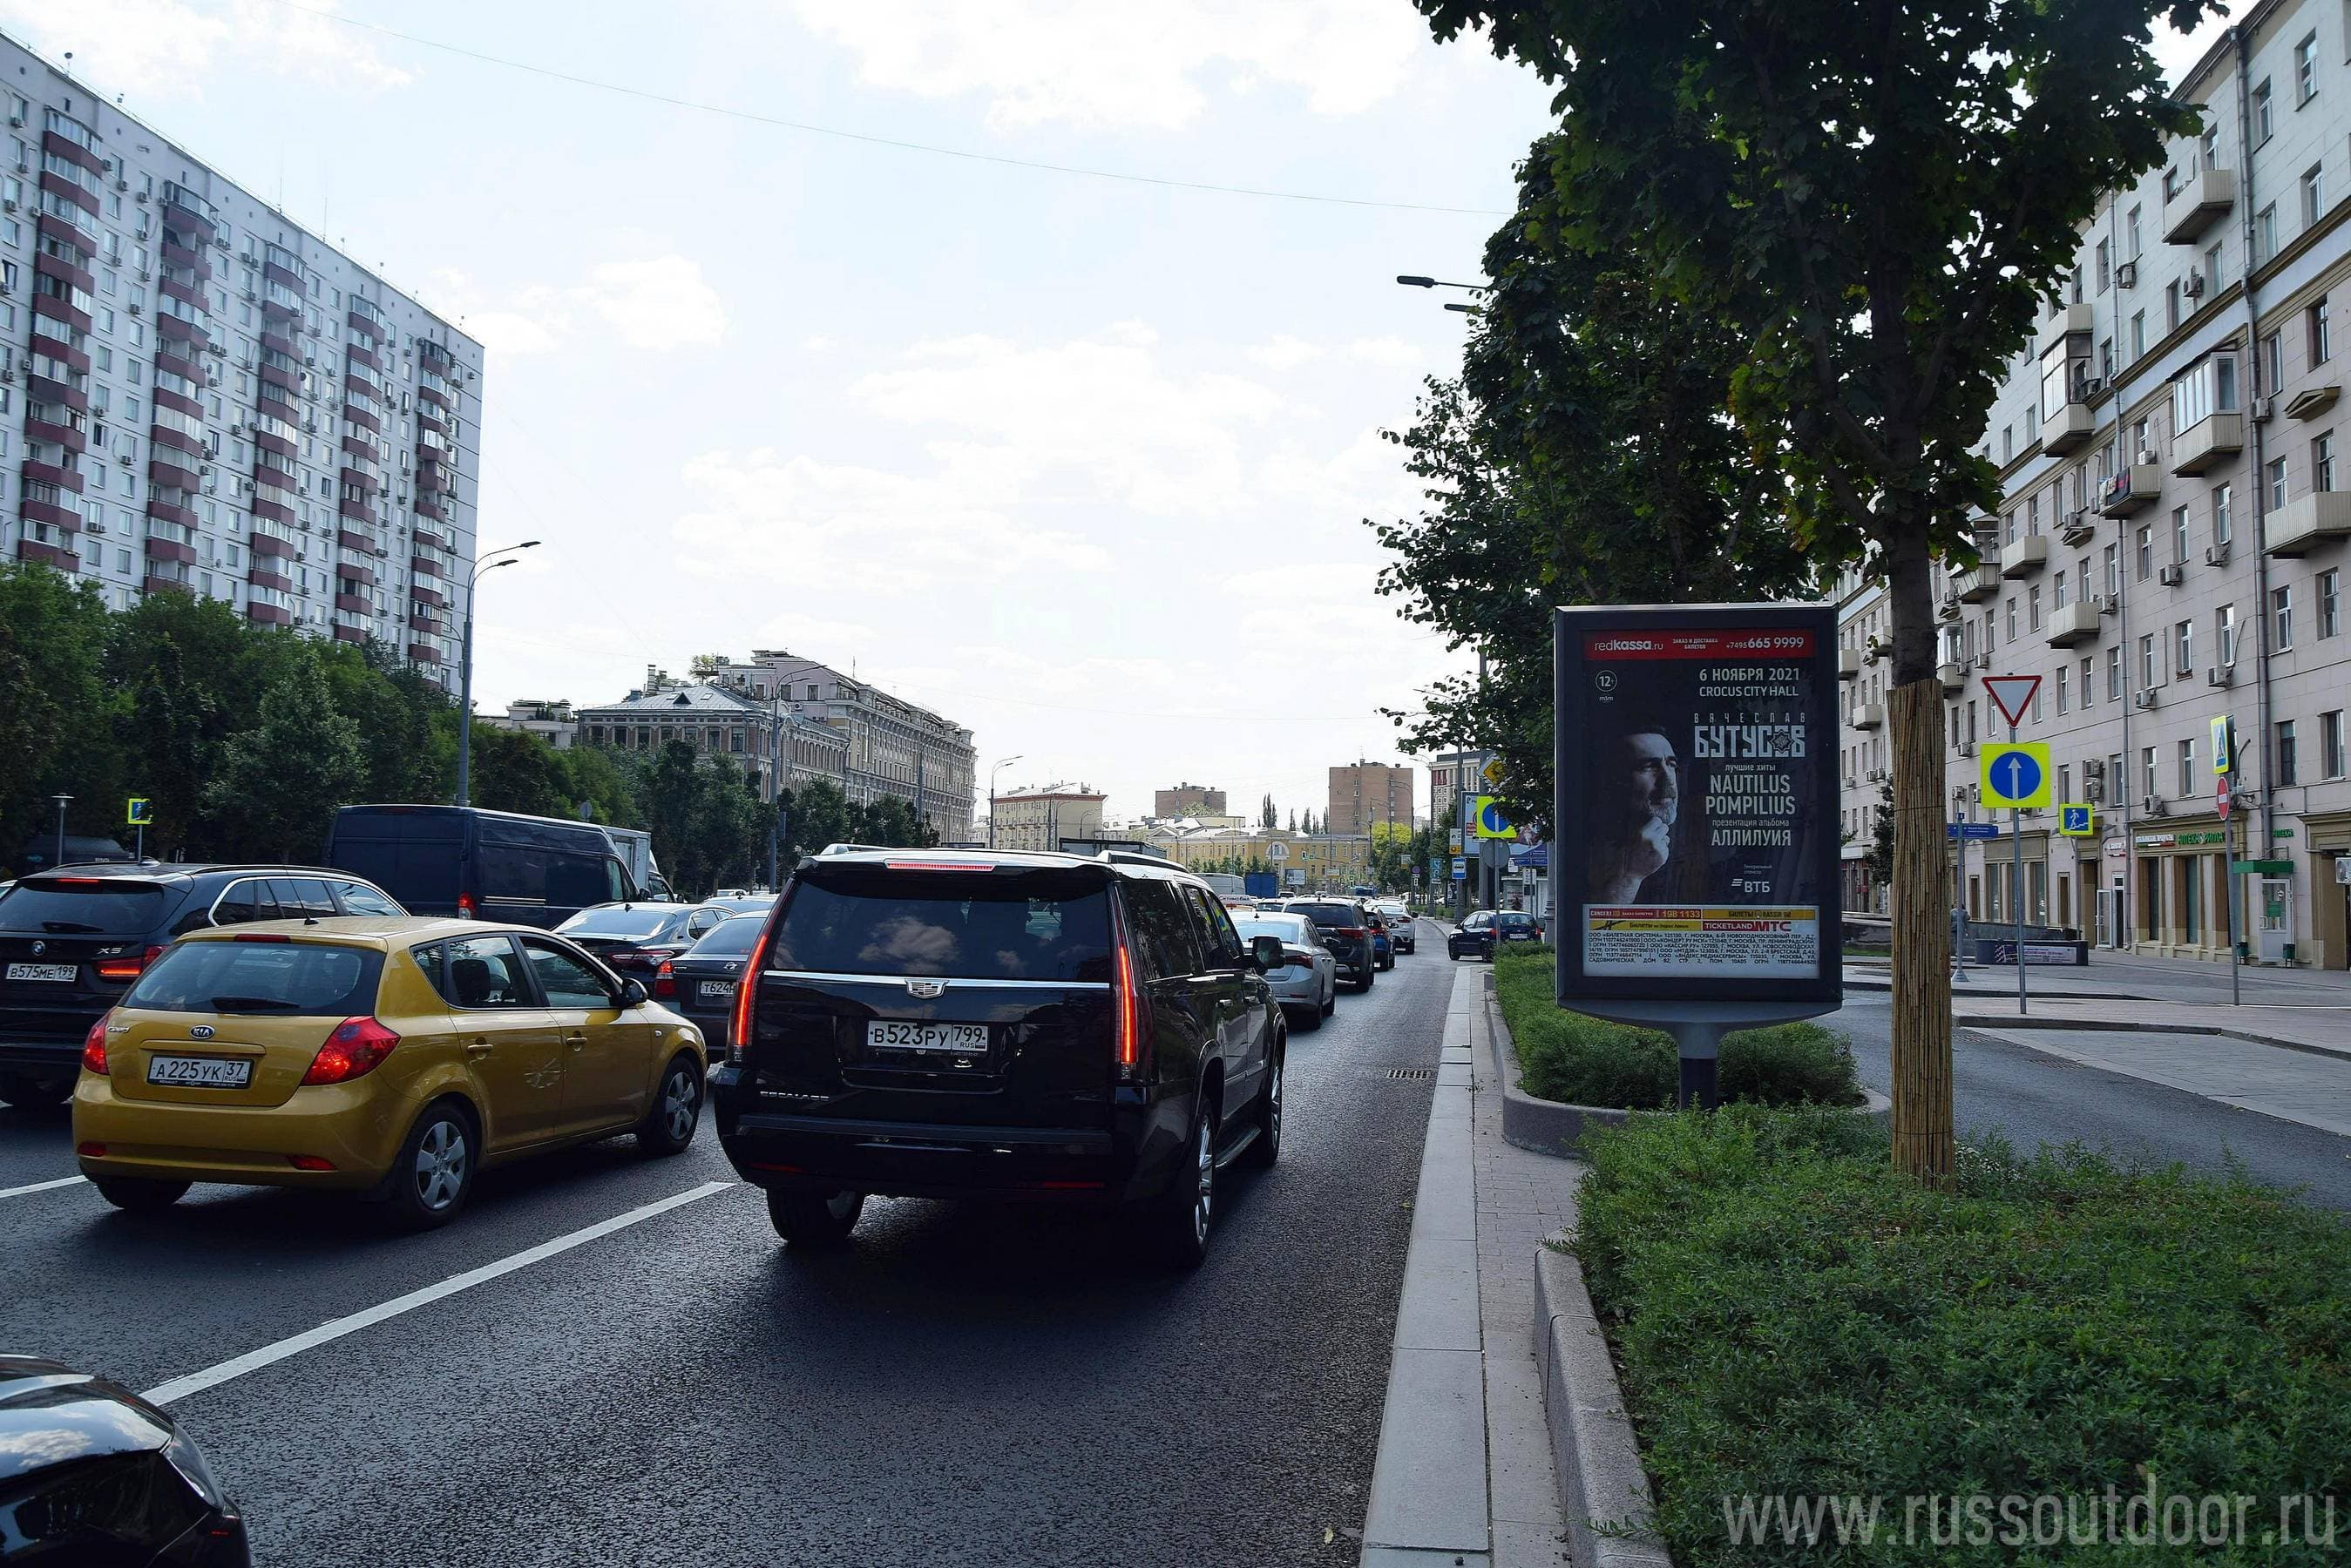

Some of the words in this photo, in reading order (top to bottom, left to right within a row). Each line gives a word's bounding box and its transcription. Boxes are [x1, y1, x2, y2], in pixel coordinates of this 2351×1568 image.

[1595, 639, 1663, 652] redkassa.ru
[1774, 637, 1804, 648] 9999
[1699, 669, 1708, 681] 6
[1712, 669, 1764, 681] НОЯБРЯ
[1769, 668, 1799, 681] 2021
[1699, 686, 1743, 697] CROCUS
[1745, 686, 1767, 697] CITY
[1769, 686, 1799, 697] HALL
[1694, 713, 1806, 723] ВЯЧЕСЛАВ
[1724, 765, 1755, 774] лучшие
[1710, 774, 1791, 794] NAUTILUS
[1706, 796, 1796, 815] POMPILIUS
[1712, 819, 1757, 828] презентация
[1758, 817, 1790, 826] альбома
[1711, 829, 1792, 846] АЛЛИЛУИЯ
[1745, 882, 1771, 893] ВТБ
[10, 965, 54, 978] В575МЕ
[58, 966, 75, 977] 199
[873, 1024, 950, 1045] В523РУ
[953, 1026, 983, 1041] 799
[156, 1061, 221, 1081] А225УК
[227, 1063, 244, 1076] 37
